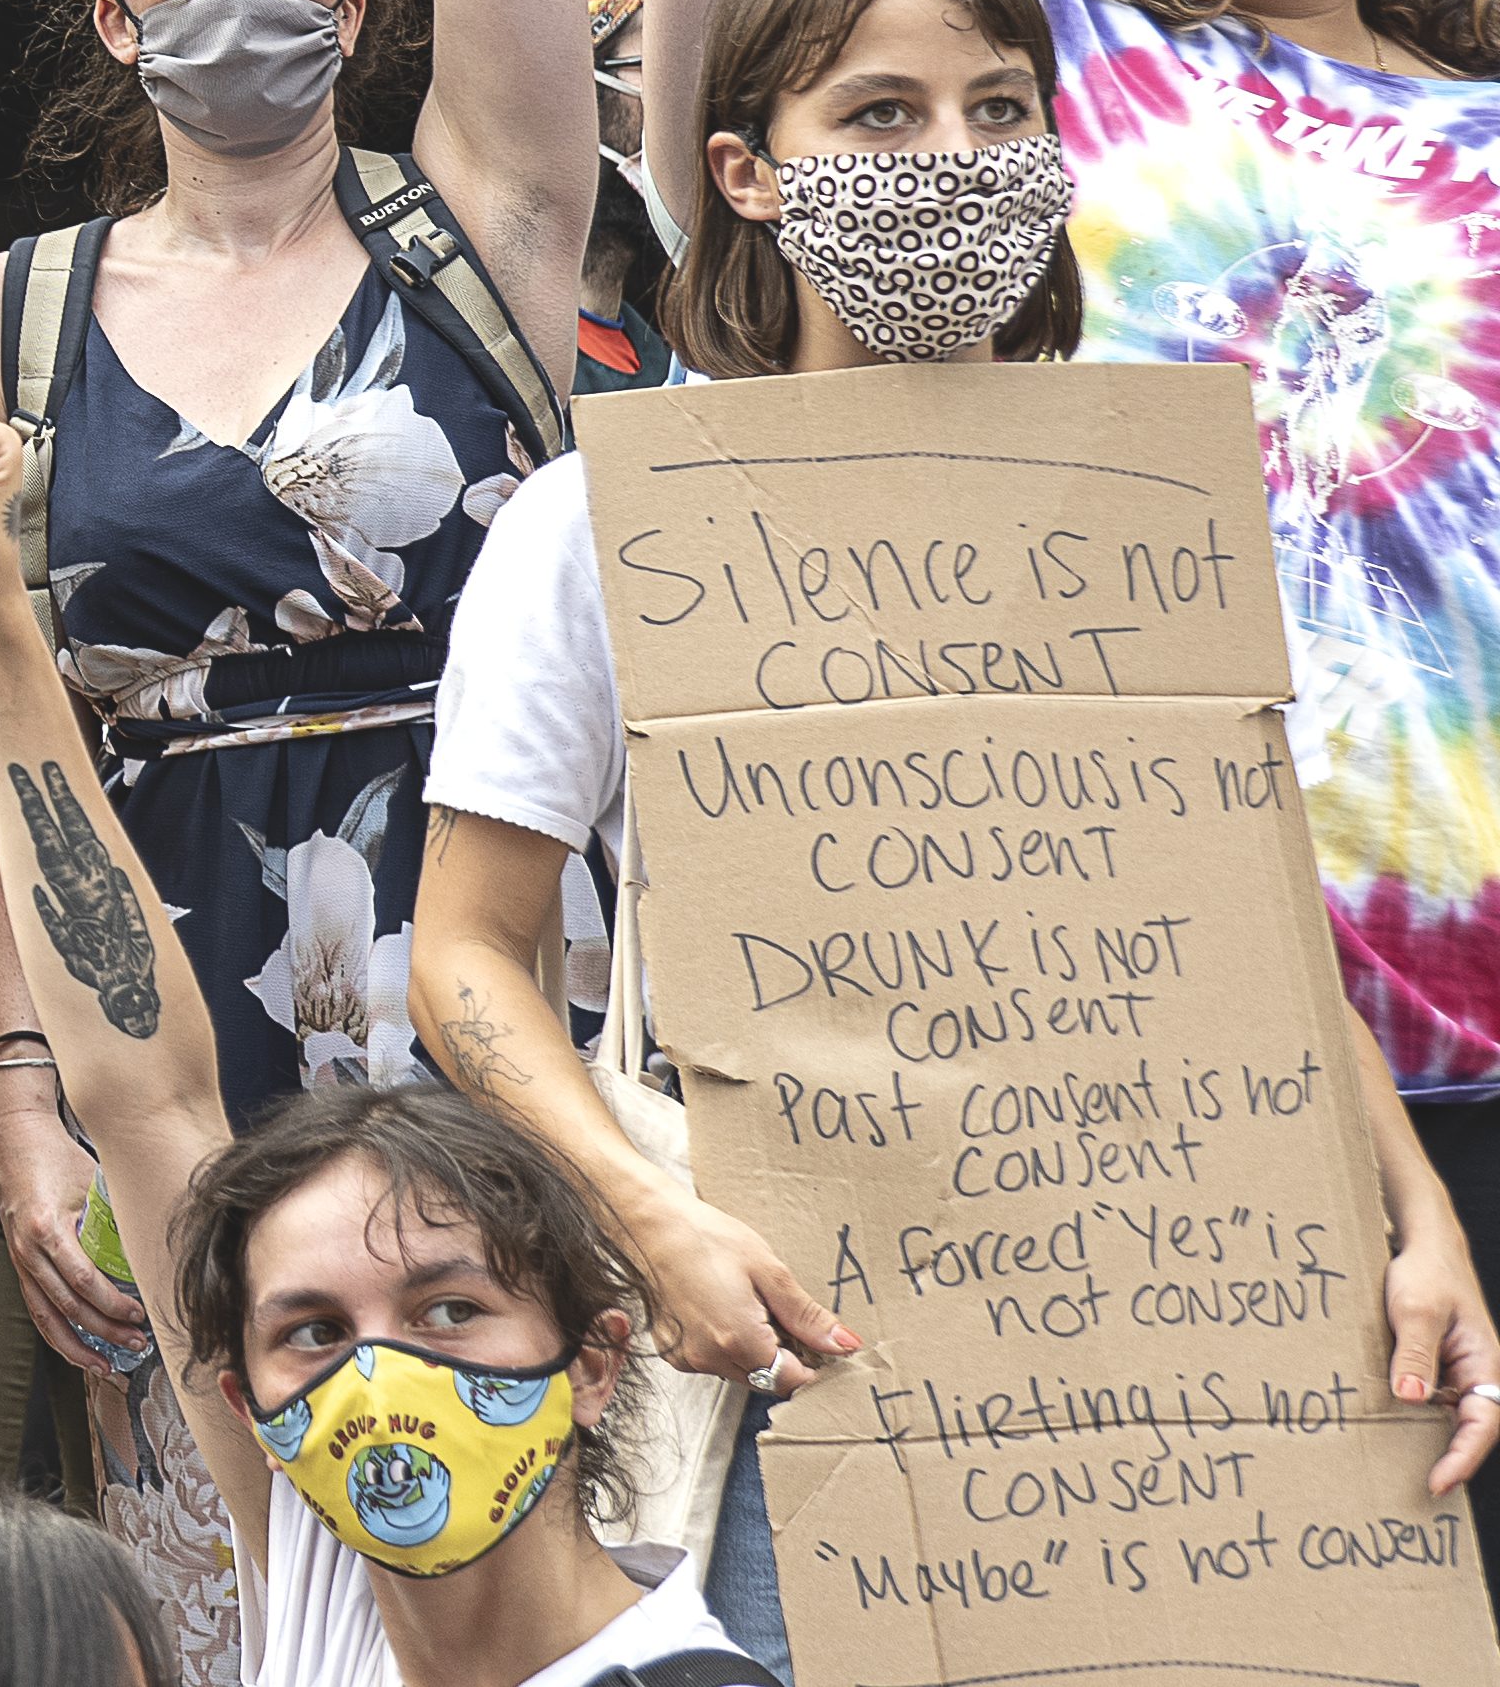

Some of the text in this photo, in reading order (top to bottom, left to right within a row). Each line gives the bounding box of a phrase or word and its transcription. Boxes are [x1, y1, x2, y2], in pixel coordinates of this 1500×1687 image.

[359, 182, 434, 227] BURTON
[617, 510, 993, 628] Silence
[1122, 517, 1235, 615] not
[1213, 742, 1286, 812] not
[731, 918, 1009, 1013] DRUNK
[772, 1069, 923, 1148] Past
[1179, 1060, 1223, 1120] is
[1242, 1049, 1322, 1116] not
[827, 1222, 877, 1313] A
[899, 1208, 1088, 1297] forced
[1262, 1208, 1327, 1273] is
[986, 1281, 1111, 1339] not
[327, 1413, 437, 1460] GROUP HUG
[1260, 1371, 1360, 1433] not
[488, 1447, 537, 1524] GROUP
[1100, 1538, 1148, 1594] is
[1183, 1510, 1279, 1584] not
